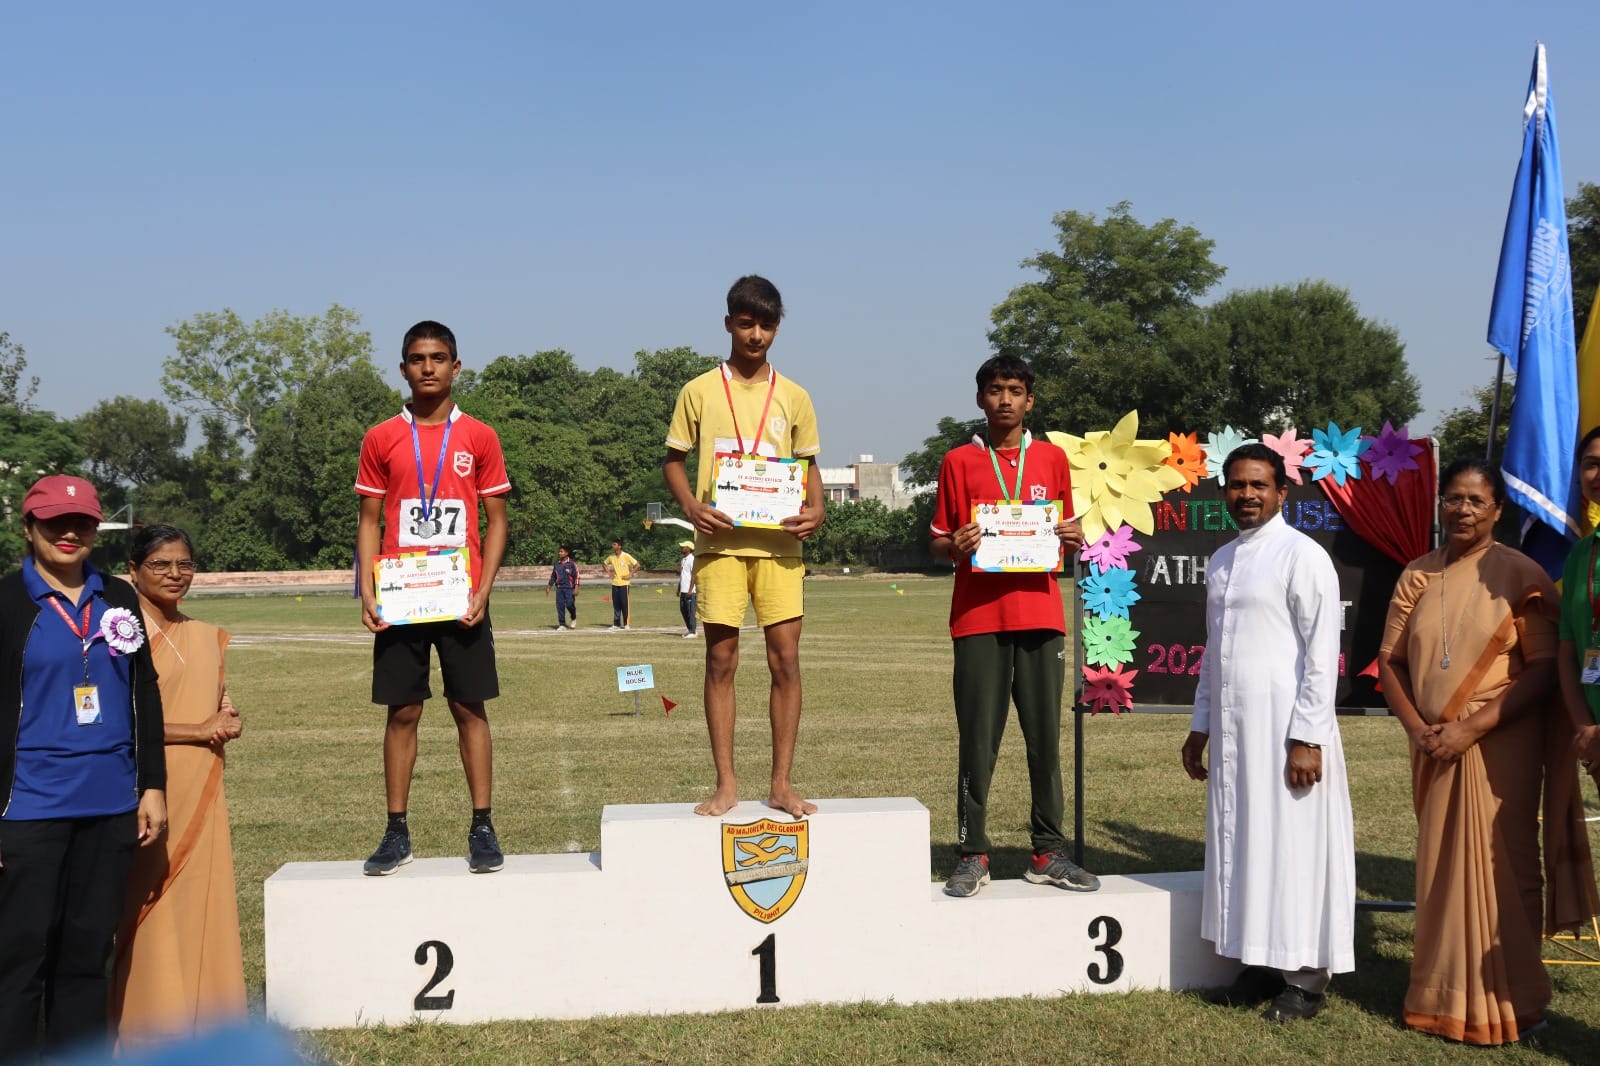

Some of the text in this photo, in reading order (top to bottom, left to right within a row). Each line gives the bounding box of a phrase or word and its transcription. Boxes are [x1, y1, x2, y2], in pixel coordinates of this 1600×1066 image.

[410, 506, 460, 535] 337
[1282, 500, 1345, 531] USE
[1150, 555, 1209, 585] ATH
[1147, 643, 1206, 675] 202
[726, 827, 735, 835] AD
[767, 823, 777, 832] DEI
[778, 824, 805, 833] GLORIAM
[1087, 915, 1124, 985] 3
[414, 939, 455, 1011] 2
[751, 932, 780, 1004] 1
